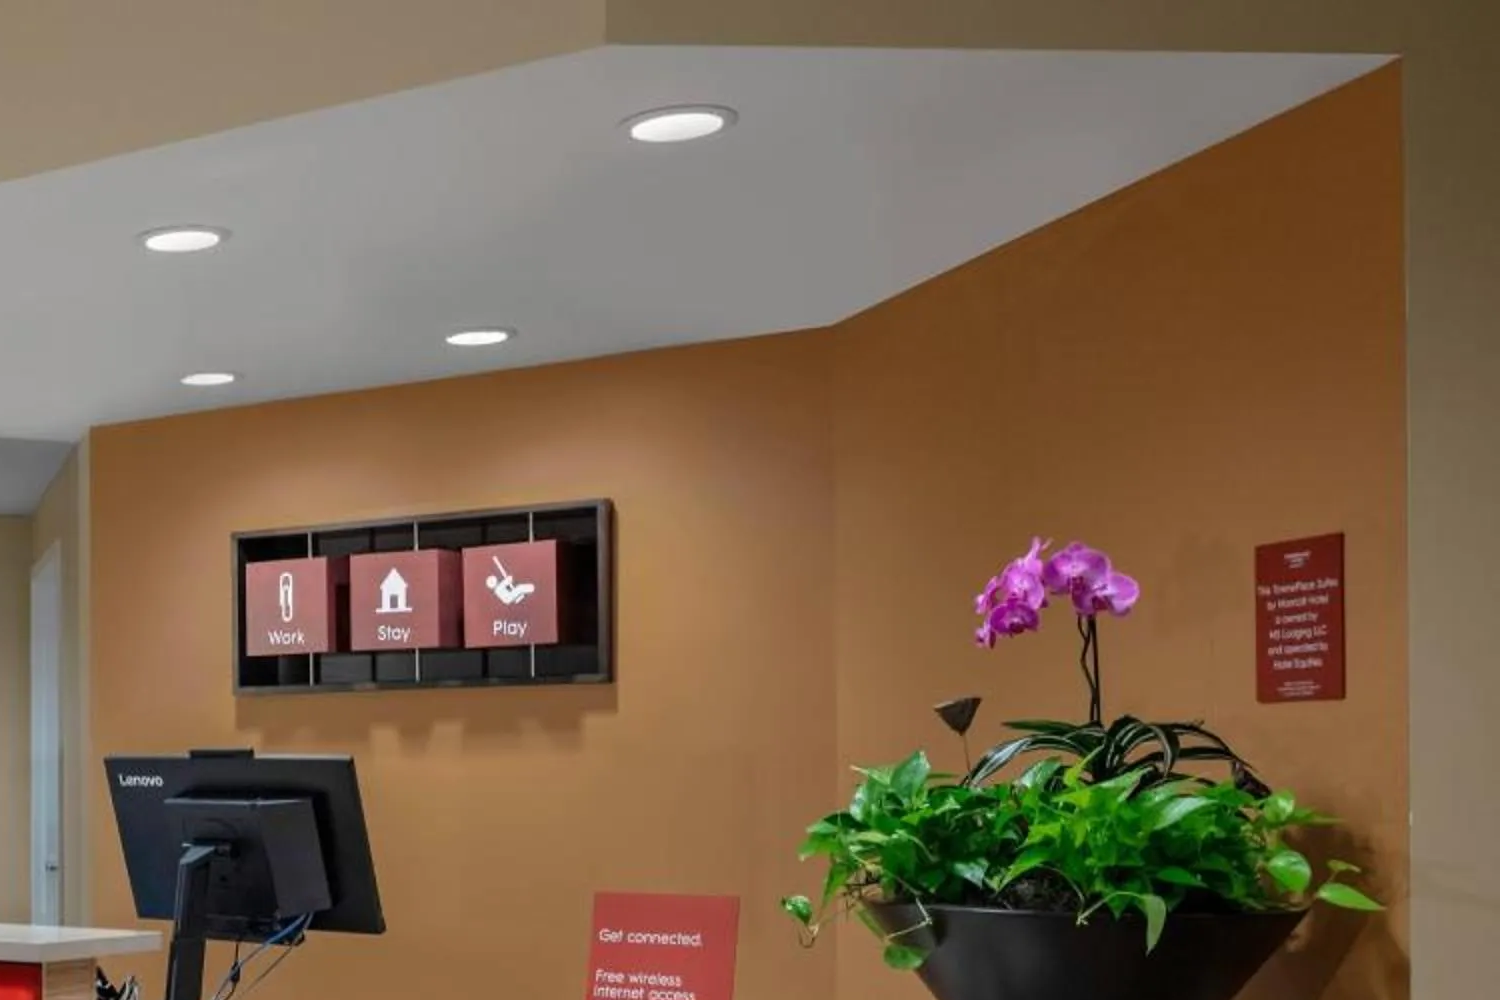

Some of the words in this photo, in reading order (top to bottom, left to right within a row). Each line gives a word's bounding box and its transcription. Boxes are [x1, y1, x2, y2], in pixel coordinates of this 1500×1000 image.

[268, 630, 305, 646] Work
[377, 625, 411, 643] Stay
[493, 619, 528, 639] Play
[119, 774, 163, 787] Lenovo
[599, 929, 622, 942] Get
[627, 931, 703, 947] connected.
[595, 969, 625, 984] Free
[629, 972, 682, 987] wireless
[593, 985, 644, 1000] internet
